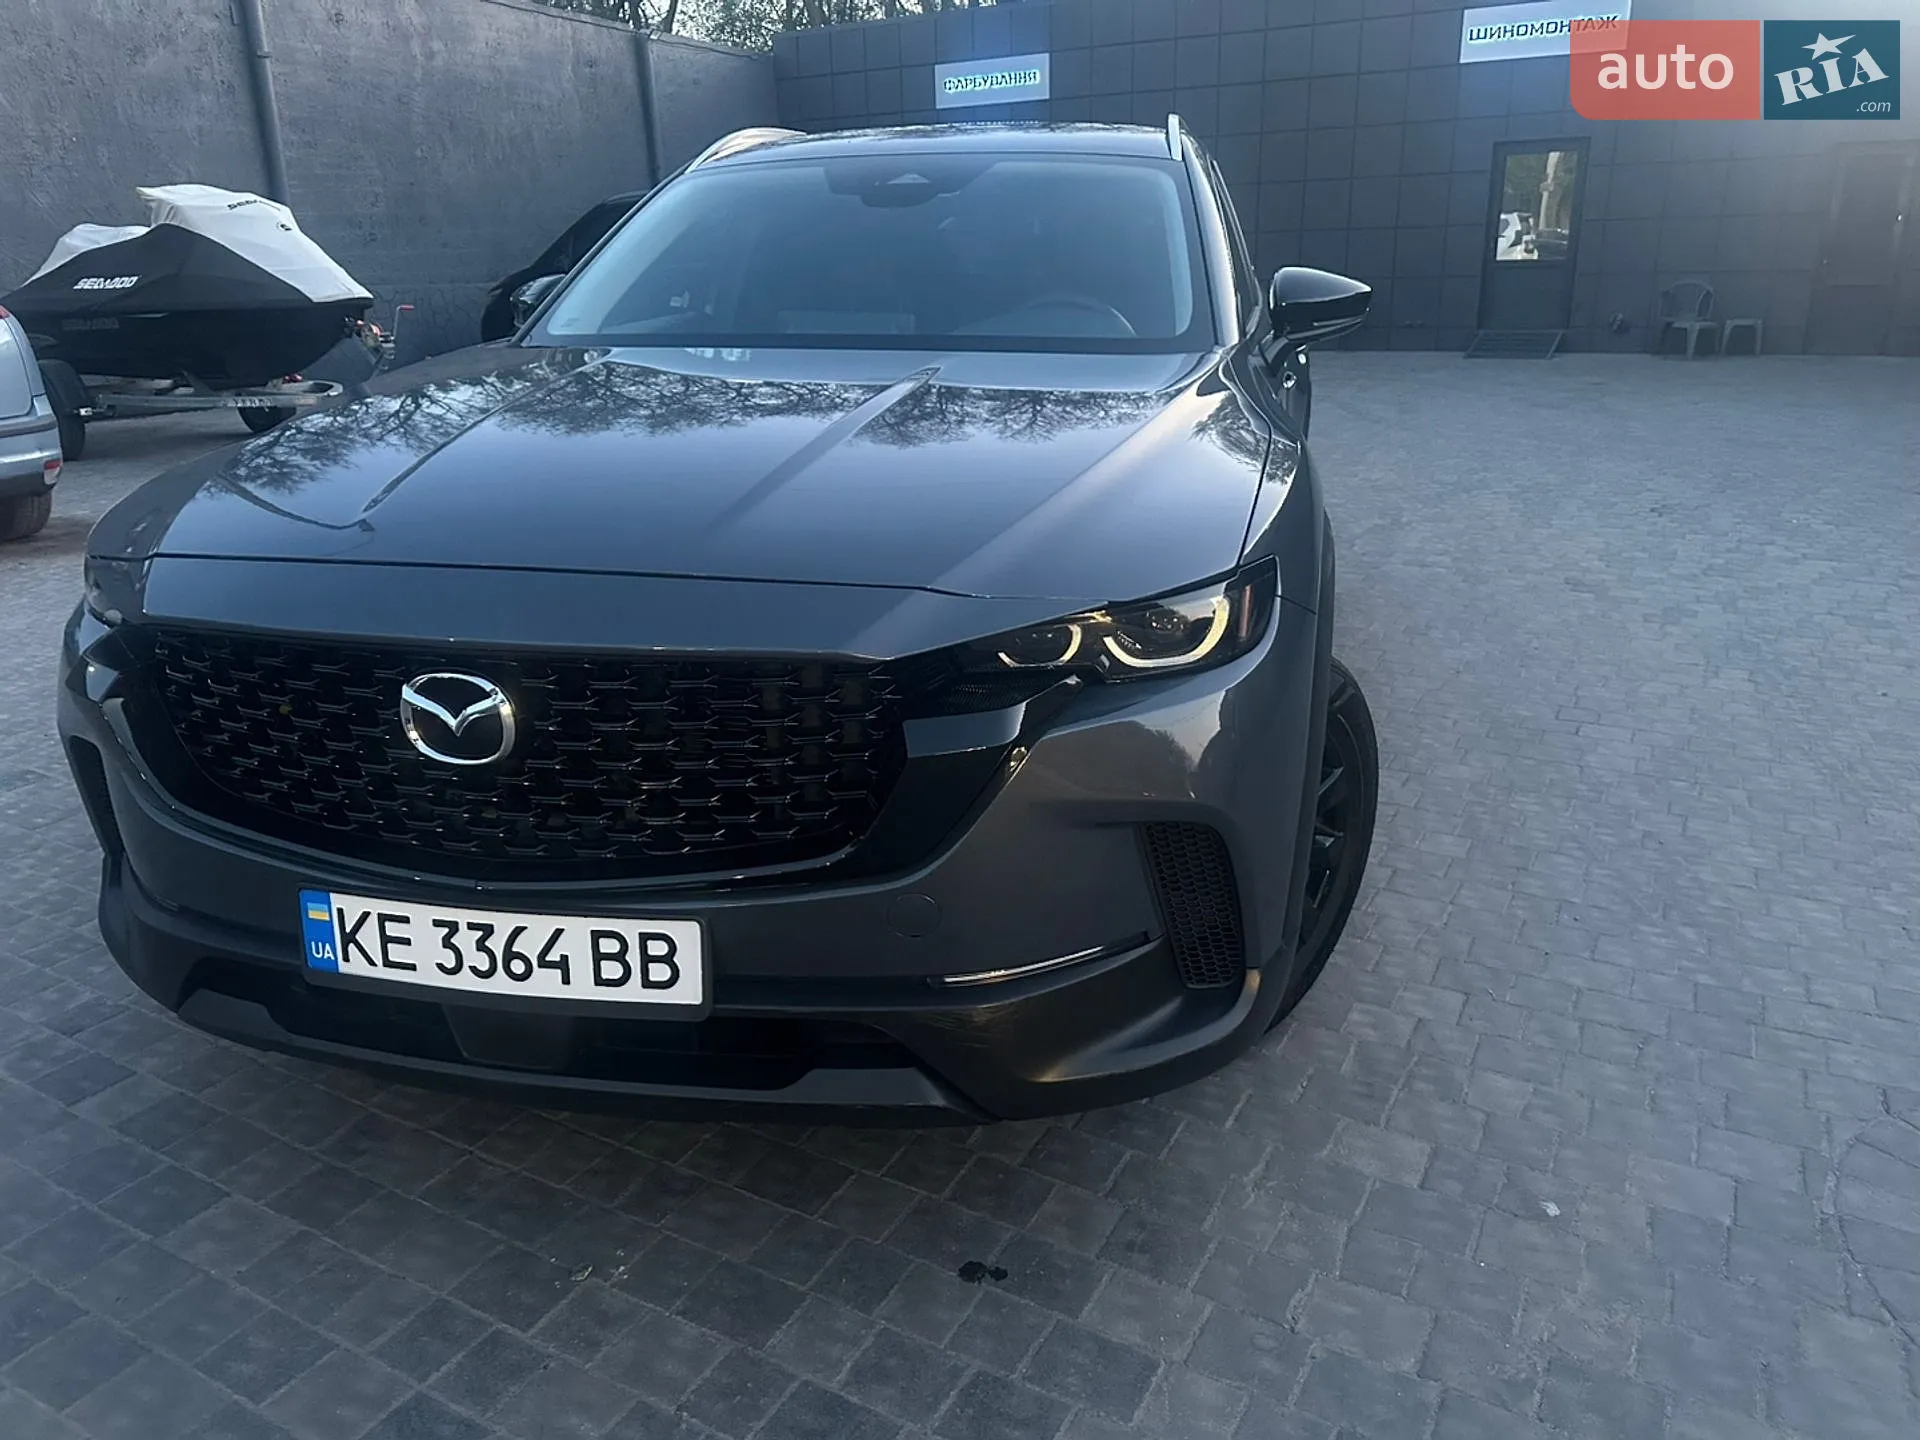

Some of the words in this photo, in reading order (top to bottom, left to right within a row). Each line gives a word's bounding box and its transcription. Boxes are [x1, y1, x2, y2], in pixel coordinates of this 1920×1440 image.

[1468, 15, 1618, 41] ШИНОМОНТАЖ
[311, 940, 335, 961] UA
[336, 906, 417, 971] KE
[432, 919, 571, 986] 3364
[590, 929, 680, 989] BB
